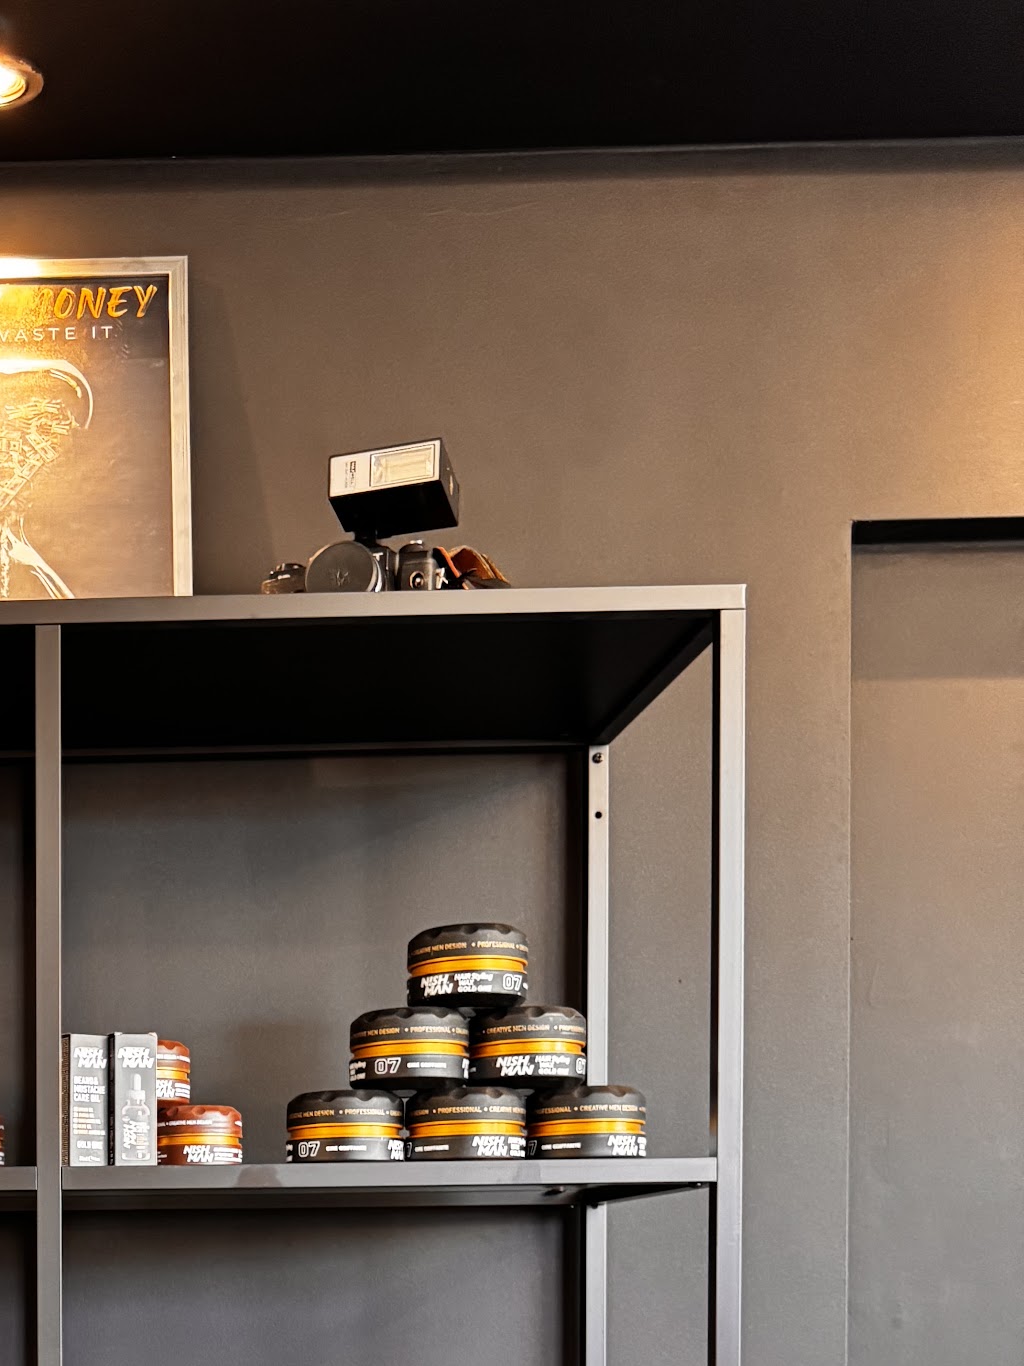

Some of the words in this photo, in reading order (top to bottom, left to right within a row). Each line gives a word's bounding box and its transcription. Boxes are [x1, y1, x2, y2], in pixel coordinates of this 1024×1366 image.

[92, 325, 114, 340] IT
[503, 973, 522, 991] 07
[424, 983, 453, 997] MAN
[78, 1058, 107, 1069] MAN
[375, 1057, 401, 1074] 07
[500, 1065, 534, 1076] MAN
[438, 1106, 482, 1114] PROFESSIONAL
[298, 1141, 320, 1157] 07
[477, 1145, 507, 1156] MAN
